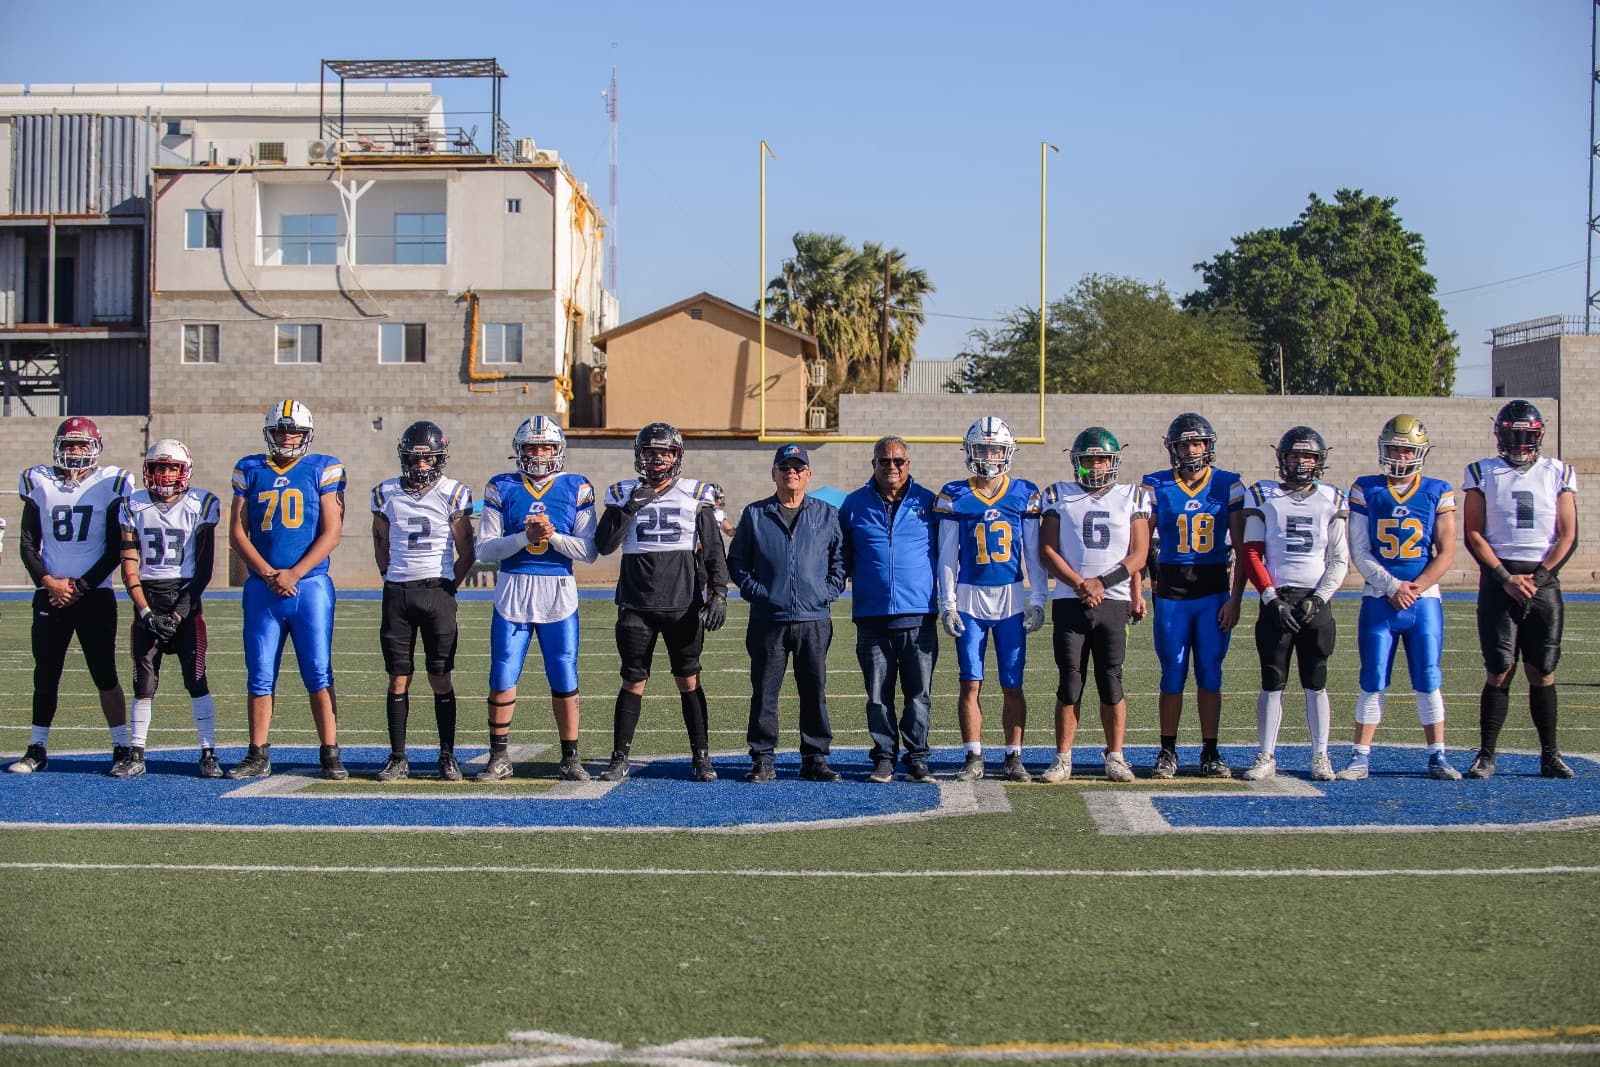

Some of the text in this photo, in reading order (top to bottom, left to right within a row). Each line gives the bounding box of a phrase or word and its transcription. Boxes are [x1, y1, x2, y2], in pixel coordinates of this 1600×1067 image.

[52, 505, 94, 542] 87
[258, 488, 304, 531] 70
[636, 507, 681, 543] 25
[1511, 491, 1535, 529] 1
[143, 527, 185, 566] 33
[407, 516, 432, 551] 2
[974, 521, 1013, 565] 13
[1083, 511, 1110, 550] 6
[1176, 513, 1215, 553] 18
[1286, 515, 1314, 553] 5
[1377, 518, 1424, 559] 52
